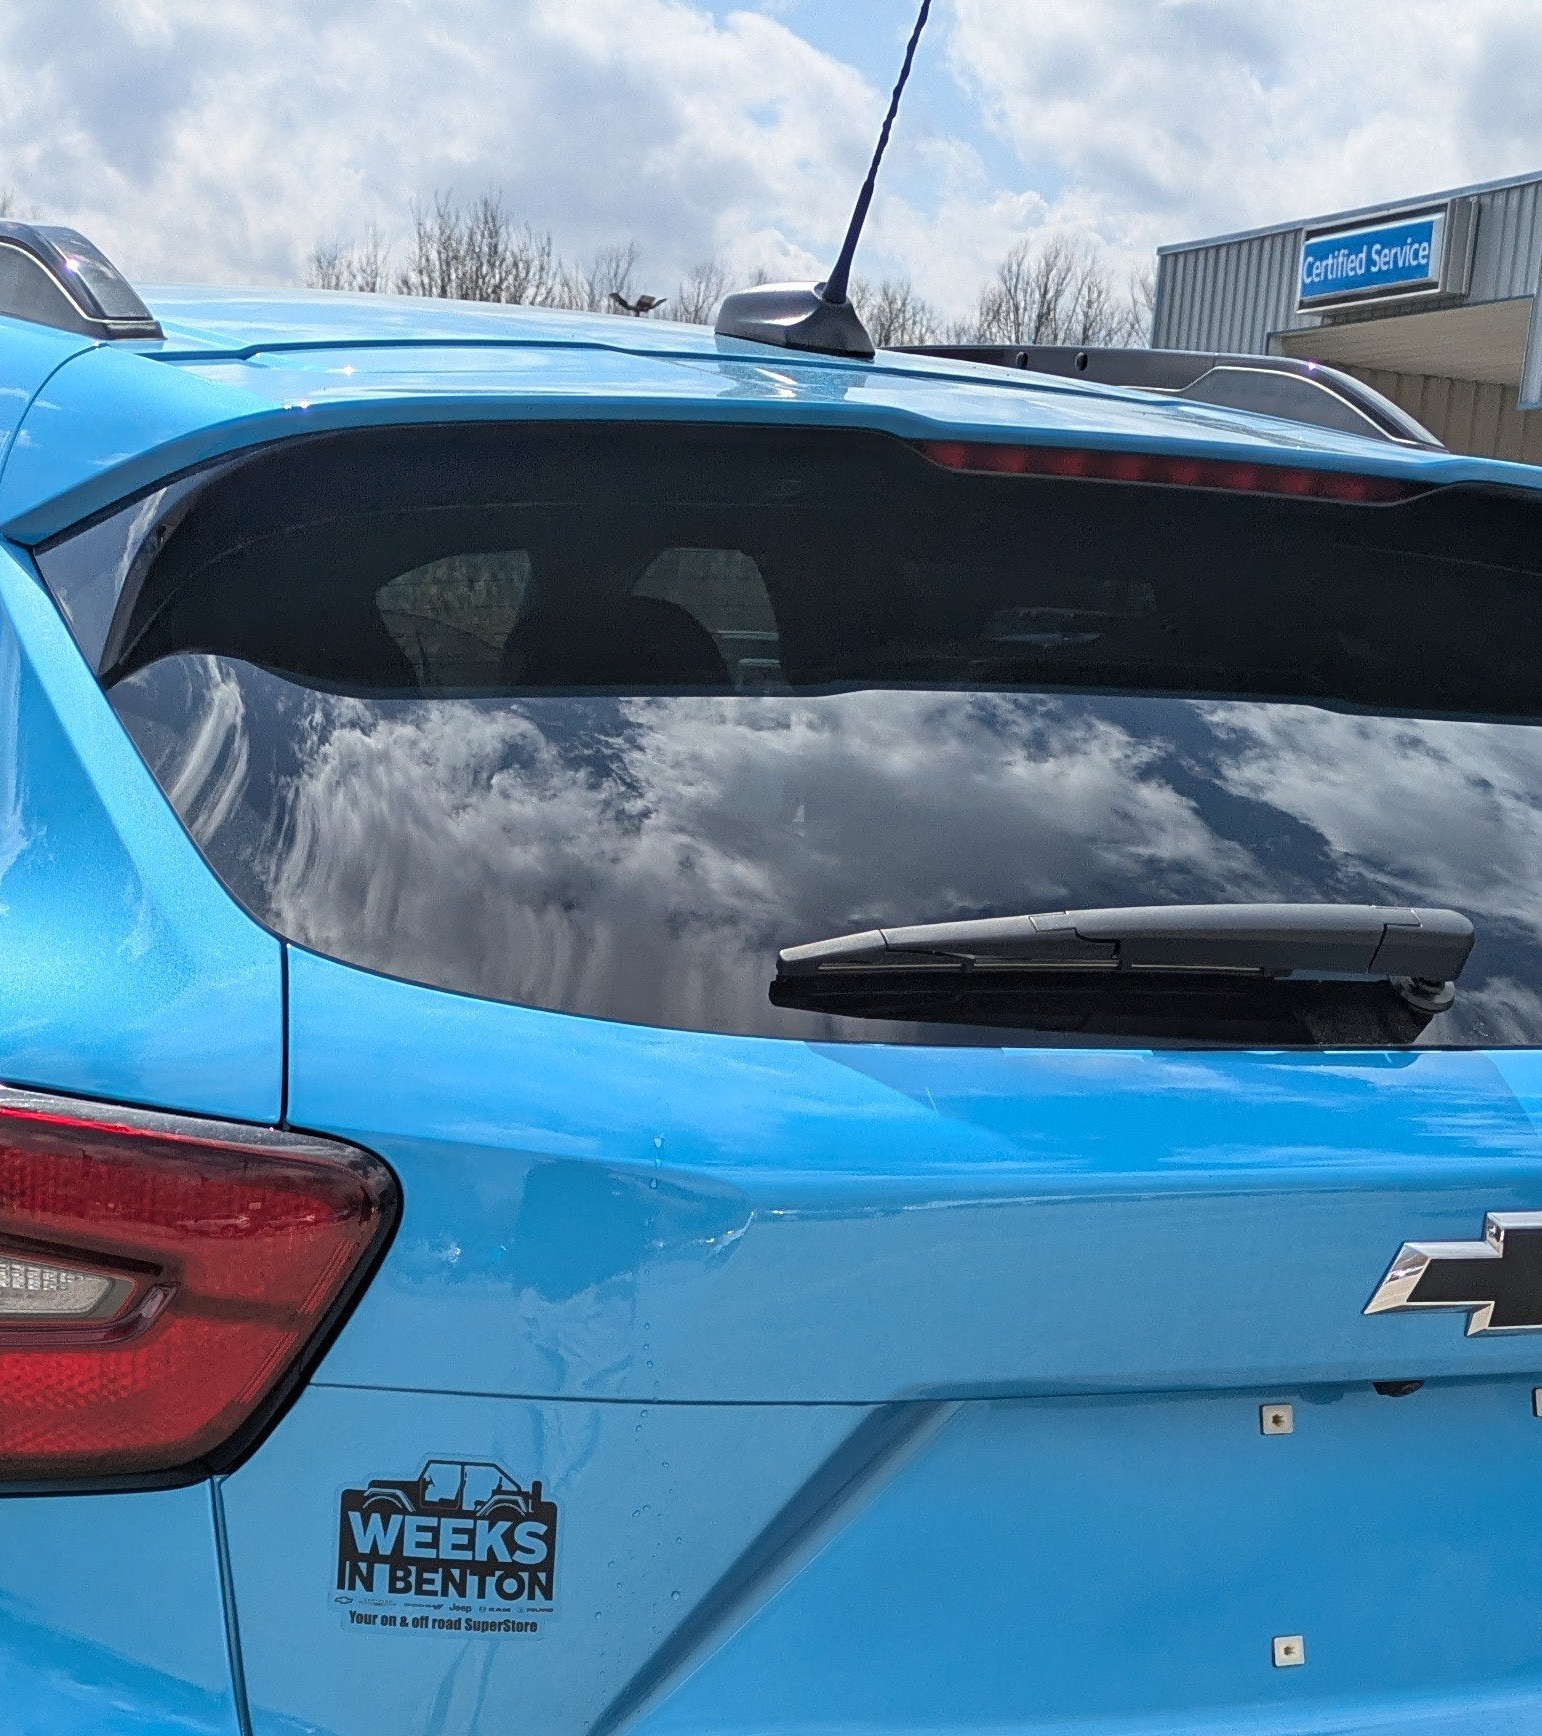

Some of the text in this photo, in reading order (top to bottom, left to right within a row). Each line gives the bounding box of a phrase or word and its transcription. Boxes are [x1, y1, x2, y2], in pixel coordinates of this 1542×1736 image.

[1303, 237, 1429, 284] Certified Service
[348, 1510, 549, 1565] WEEKS
[337, 1560, 554, 1601] IN BENTON
[349, 1610, 538, 1633] Your on & off road SuperStore
[449, 1602, 472, 1613] Jeep
